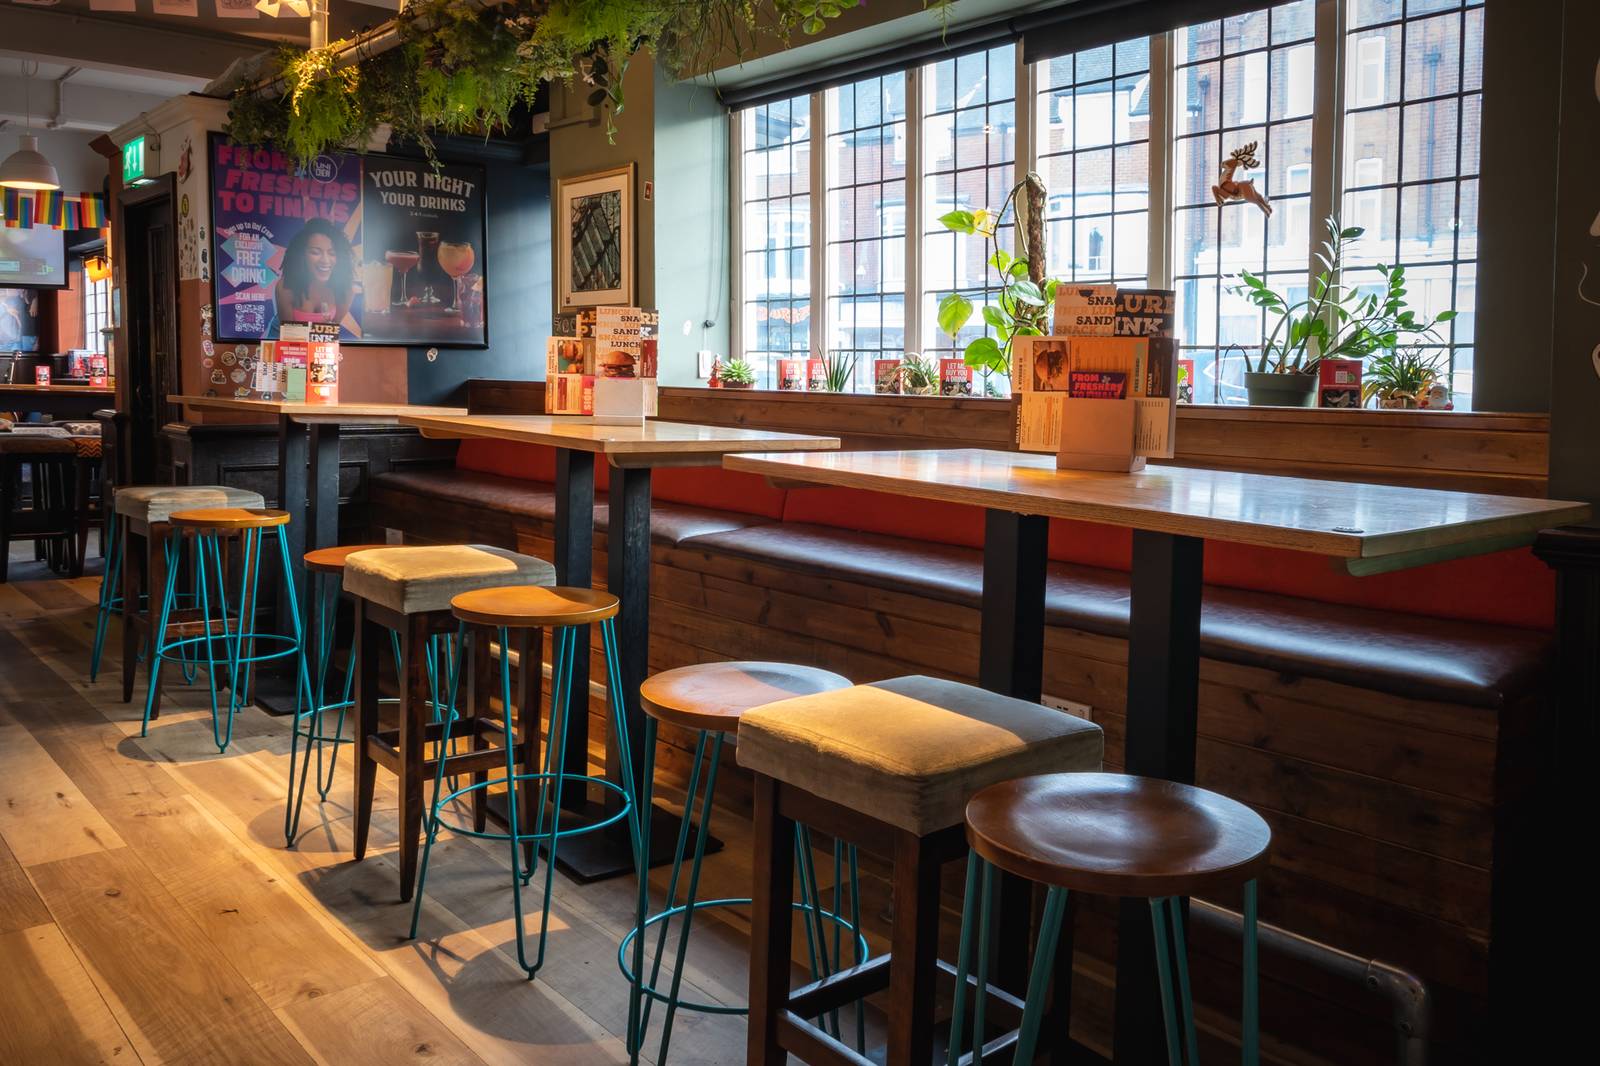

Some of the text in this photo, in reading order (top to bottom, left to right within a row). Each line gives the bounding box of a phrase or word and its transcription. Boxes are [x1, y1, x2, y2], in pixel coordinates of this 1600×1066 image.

[225, 169, 358, 201] FRESHERS
[369, 170, 476, 198] YOUR NIGHT
[217, 190, 350, 222] TO FINALS
[380, 191, 467, 212] YOUR DRINKS
[240, 232, 251, 241] FOR
[236, 250, 262, 267] FREE
[231, 266, 266, 284] DRINK!
[235, 291, 251, 300] SCAN
[1087, 296, 1115, 306] SNA
[1076, 316, 1115, 326] SAND
[1072, 373, 1099, 382] FROM
